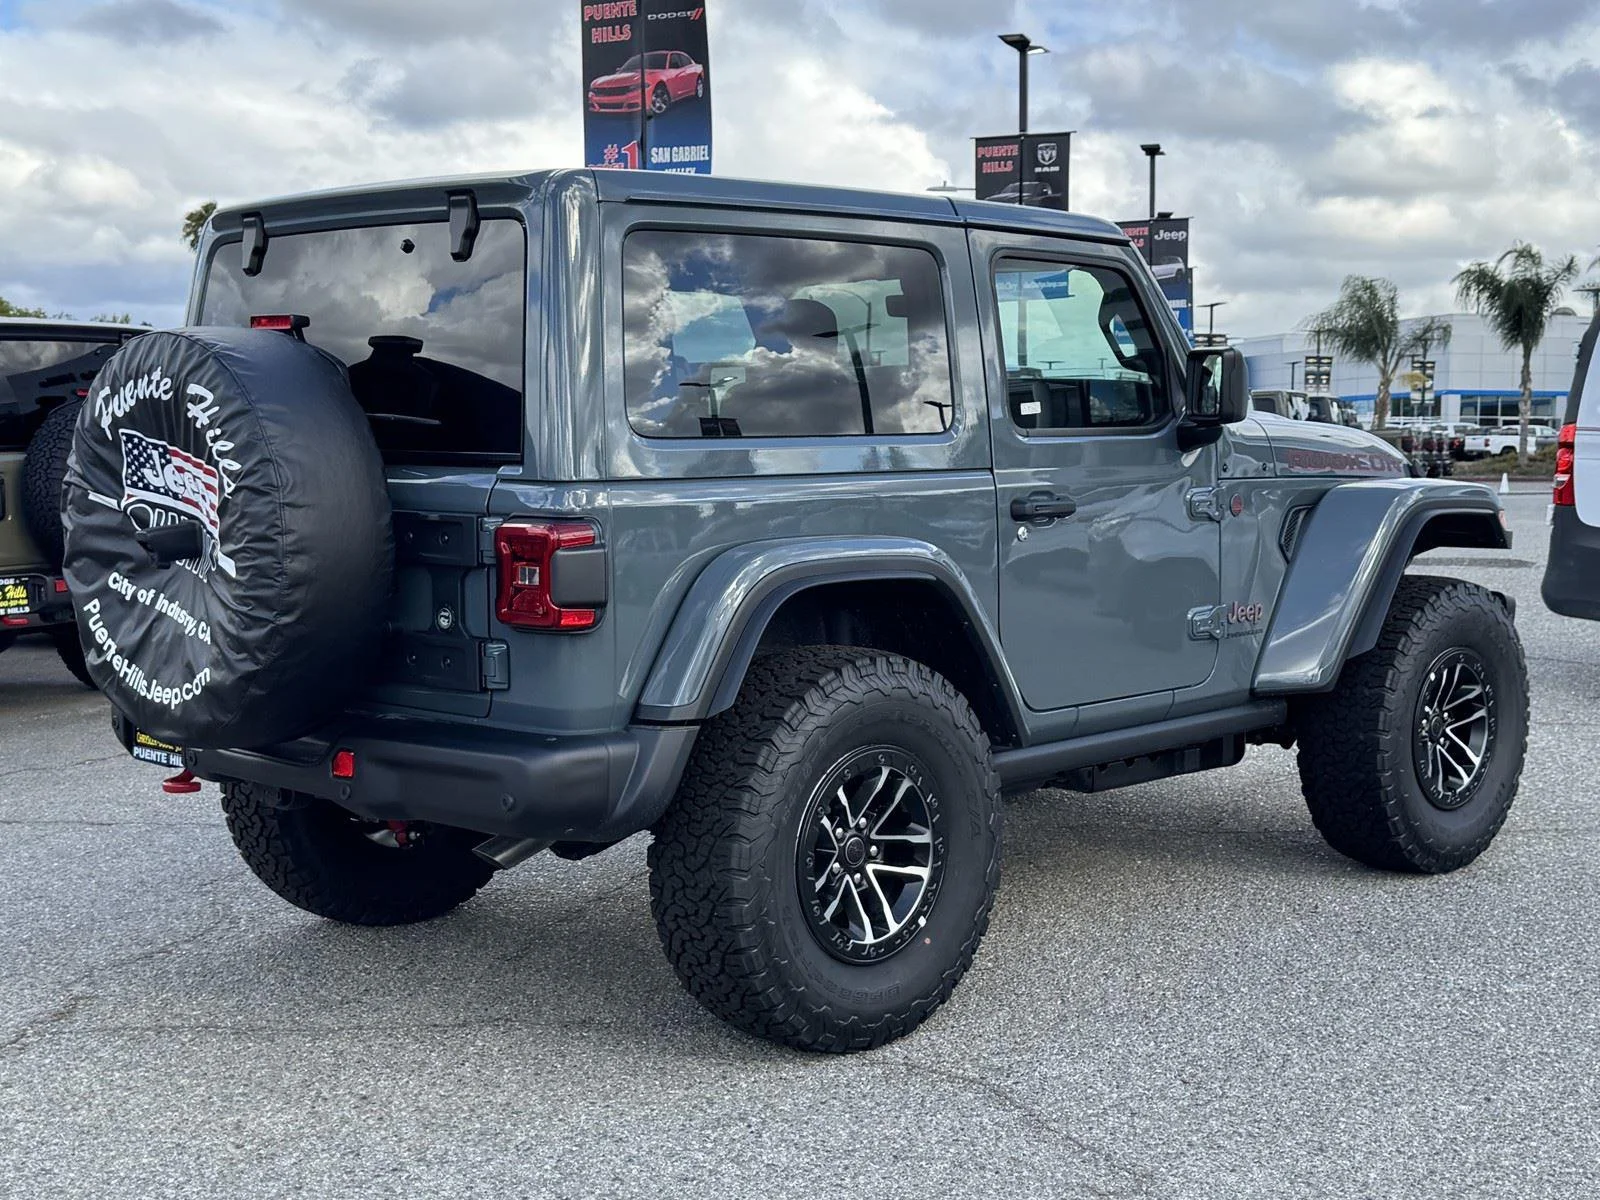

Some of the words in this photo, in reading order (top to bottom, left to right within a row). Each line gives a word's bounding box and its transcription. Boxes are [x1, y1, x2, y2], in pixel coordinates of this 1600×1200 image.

[583, 0, 637, 21] PUENTE
[647, 9, 695, 20] DODGE
[591, 24, 631, 43] HILLS
[651, 147, 671, 164] SAN
[671, 144, 709, 162] GABRIEL
[977, 144, 1019, 158] PUENTE
[982, 160, 1013, 173] HILLS
[1154, 229, 1187, 241] Jeep
[95, 366, 173, 440] Puente
[107, 571, 137, 601] City
[137, 588, 156, 606] of
[197, 621, 211, 645] CA
[1227, 600, 1263, 625] Jeep
[133, 746, 168, 764] PUENTE
[169, 753, 185, 767] HIL
